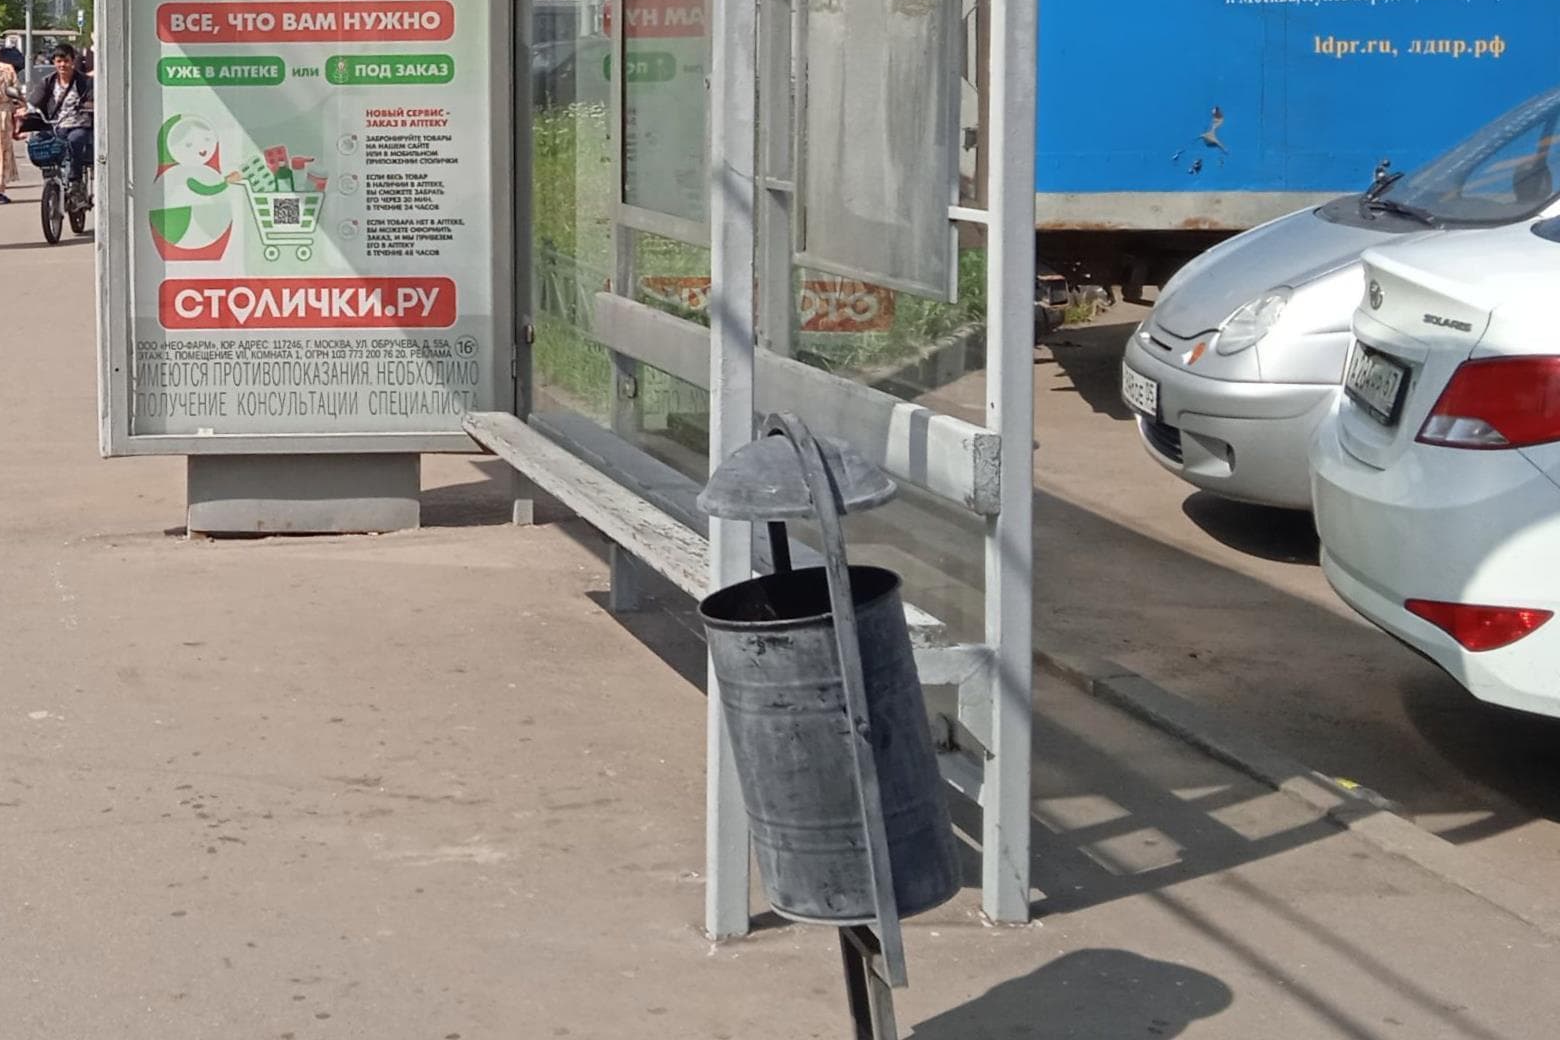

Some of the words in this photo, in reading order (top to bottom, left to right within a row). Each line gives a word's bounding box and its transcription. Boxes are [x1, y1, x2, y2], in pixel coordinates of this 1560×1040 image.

[170, 13, 220, 34] ВСЕ,
[228, 13, 276, 32] ЧТО
[282, 12, 336, 31] ВАМ
[344, 11, 441, 30] НУЖНО
[1408, 34, 1506, 58] лдпр.рф
[166, 66, 201, 78] УЖЕ
[205, 66, 215, 78] В
[219, 65, 278, 78] АПТЕКЕ
[354, 64, 391, 79] ПОД
[395, 64, 449, 77] ЗАКАЗ
[366, 107, 404, 117] НОВЫЙ
[407, 109, 444, 117] СЕРВИС
[366, 119, 398, 127] ЗАКАЗ
[400, 119, 407, 127] В
[409, 119, 448, 127] АПТЕКУ
[174, 286, 440, 325] СТОЛИЧКИ.РУ
[251, 350, 293, 359] КОМНАТА
[411, 349, 452, 358] РЕКЛАМА
[138, 362, 208, 387] ИМЕЮТСЯ
[377, 361, 479, 388] НЕОБХОДИМО
[138, 391, 228, 417] ПОЛУЧЕНИЕ
[237, 391, 358, 419] КОНСУЛЬТАЦИИ
[369, 391, 479, 419] СПЕЦИАЛИСТА
